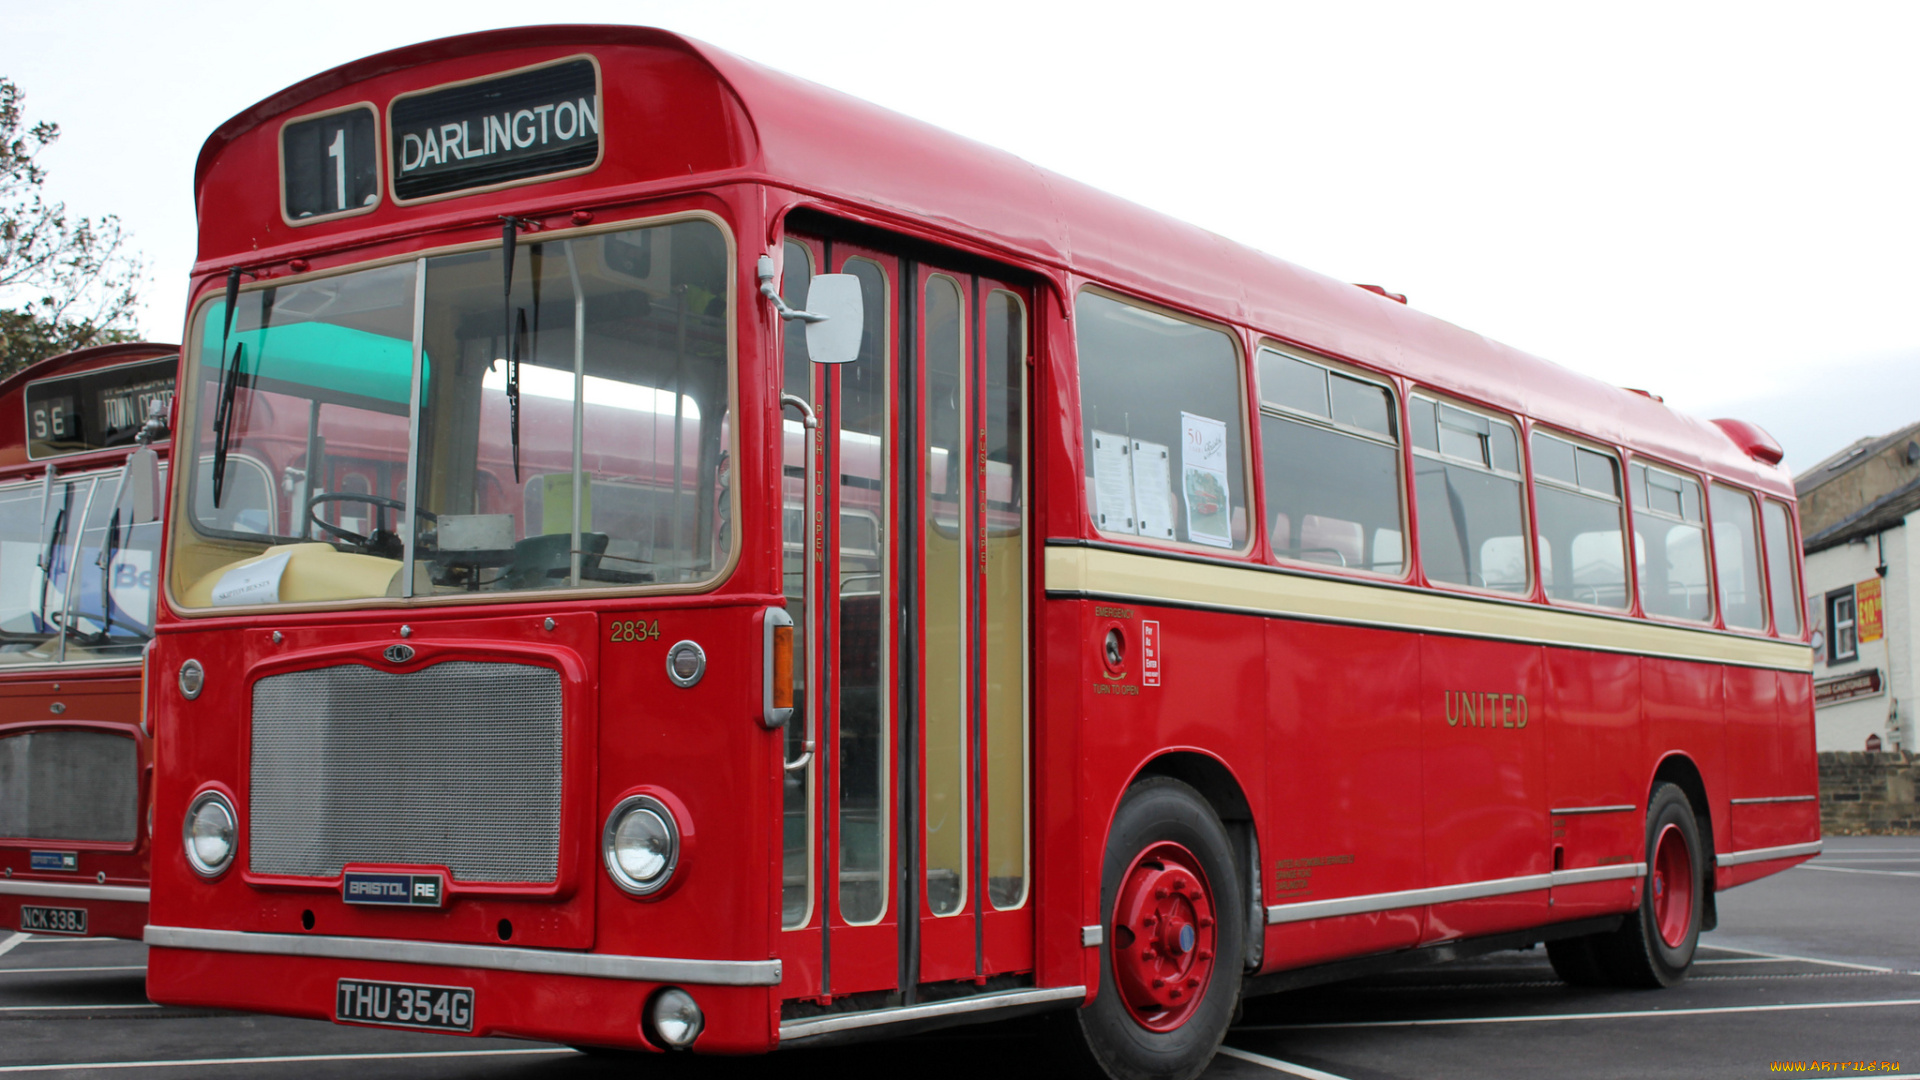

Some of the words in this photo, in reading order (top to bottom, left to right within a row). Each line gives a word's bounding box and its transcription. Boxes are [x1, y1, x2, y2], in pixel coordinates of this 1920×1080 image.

[402, 95, 598, 172] DARLINGTON
[328, 129, 346, 210] 1
[104, 396, 135, 427] TOWN
[815, 404, 823, 456] PUSH
[1187, 428, 1202, 446] 50
[979, 428, 987, 476] PUSH
[815, 470, 823, 496] TO
[979, 490, 987, 513] TO
[815, 511, 823, 562] OPEN
[979, 527, 987, 574] OPEN
[1095, 606, 1134, 619] EMERGENCY
[610, 620, 660, 642] 2834
[1093, 683, 1110, 695] TURN
[1112, 684, 1121, 695] TO
[1122, 685, 1139, 696] OPEN
[1445, 690, 1529, 729] UNITED
[349, 881, 408, 896] BRISTOL
[414, 883, 436, 897] RE
[23, 908, 48, 928] NCK
[50, 910, 86, 931] 338J
[340, 984, 392, 1019] THU
[396, 988, 469, 1026] 354G
